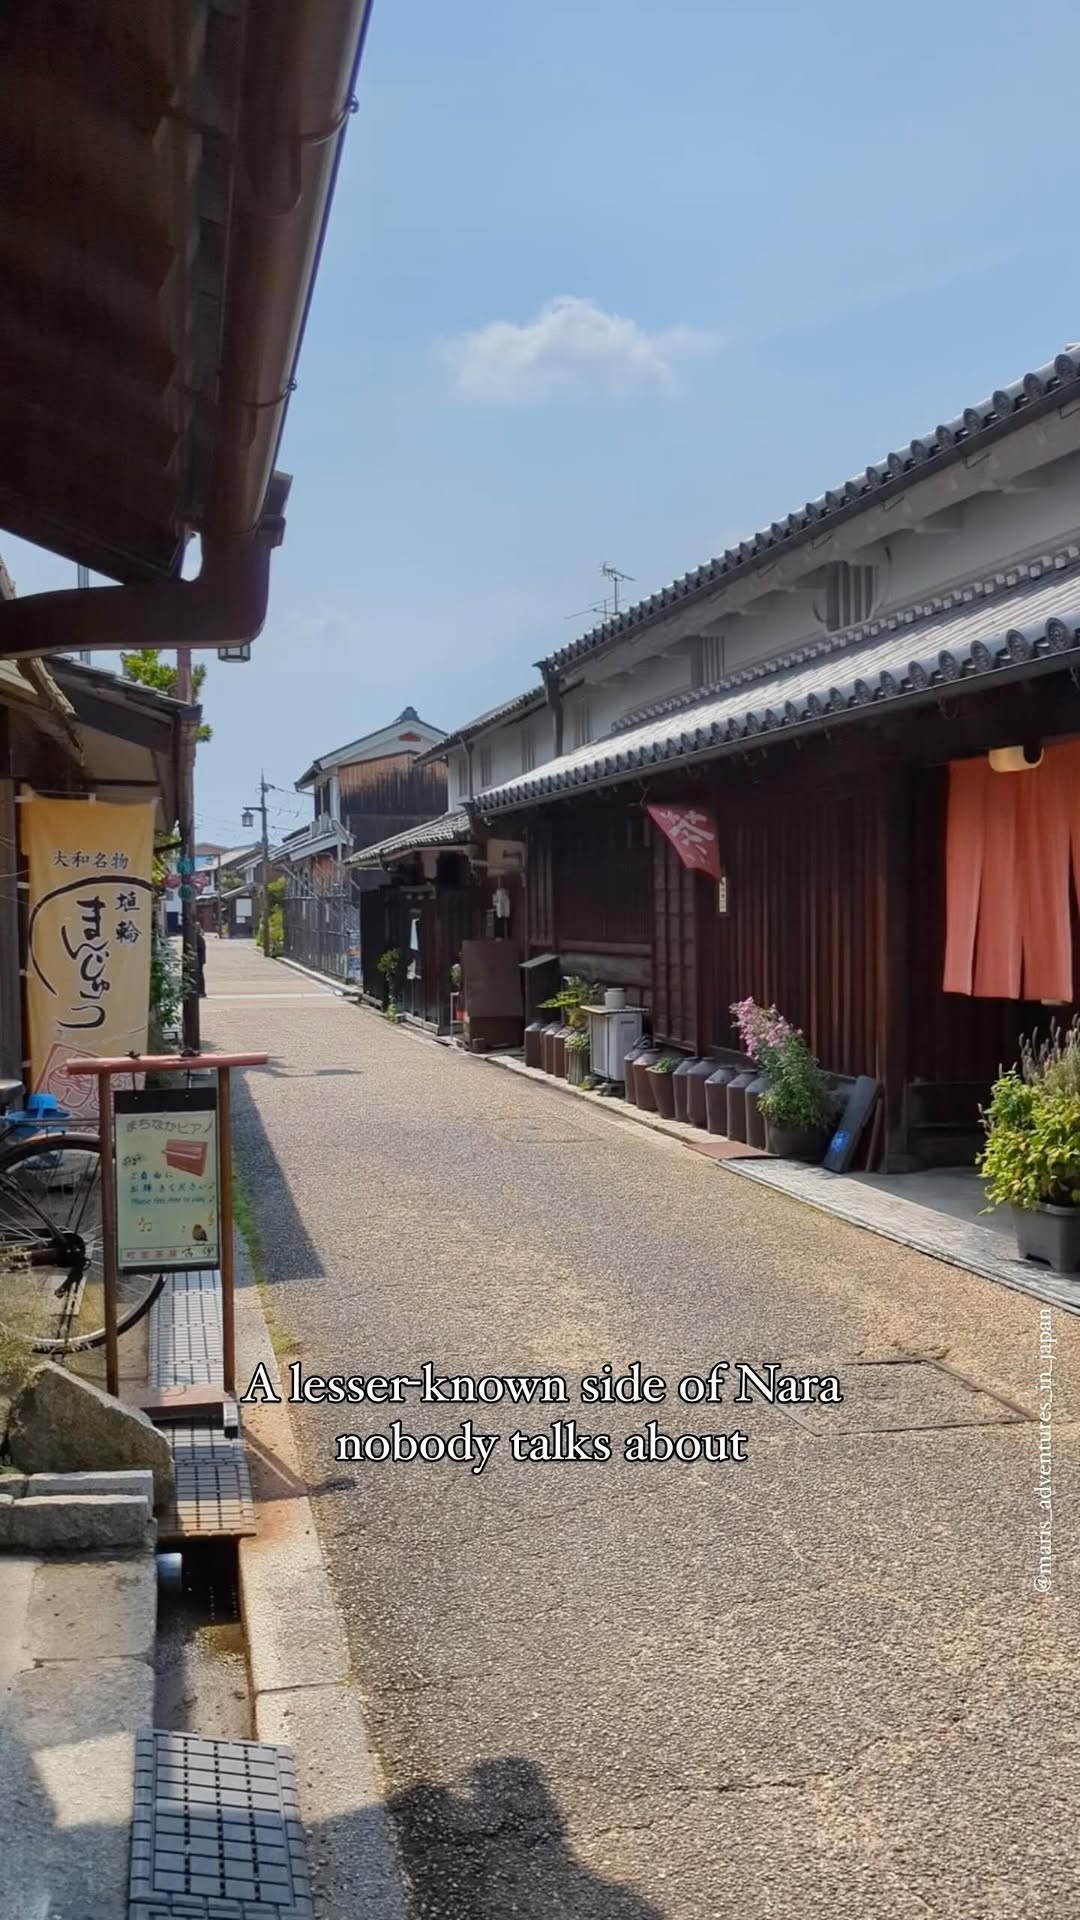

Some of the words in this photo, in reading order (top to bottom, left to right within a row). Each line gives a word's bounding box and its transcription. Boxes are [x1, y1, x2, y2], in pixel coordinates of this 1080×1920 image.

[54, 851, 128, 869] 大和名物
[126, 1119, 213, 1135] まちなかピアノ
